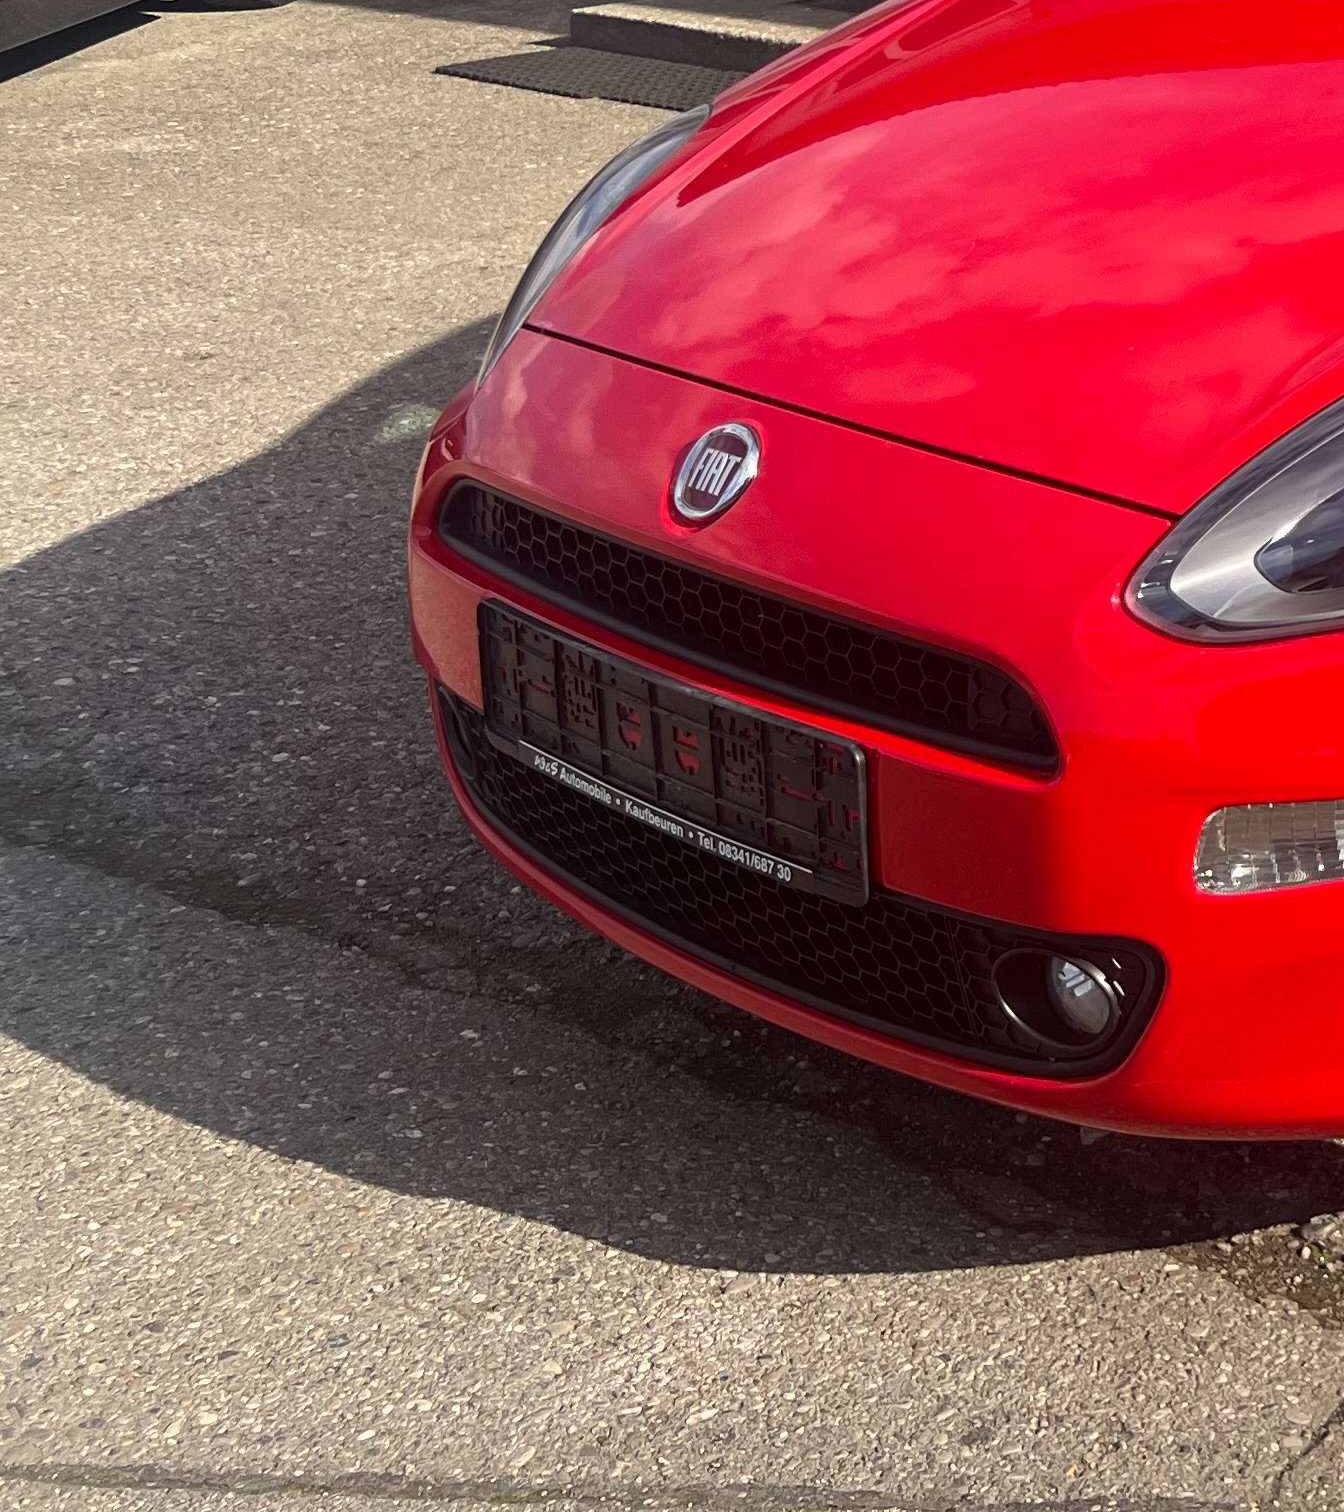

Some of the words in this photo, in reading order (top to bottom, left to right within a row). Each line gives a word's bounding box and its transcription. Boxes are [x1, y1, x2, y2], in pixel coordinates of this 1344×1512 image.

[687, 447, 742, 497] FIAT
[559, 767, 612, 805] Automobile
[625, 798, 684, 838] Kaufbeuren
[697, 830, 717, 853] Tel.
[777, 863, 792, 883] 30
